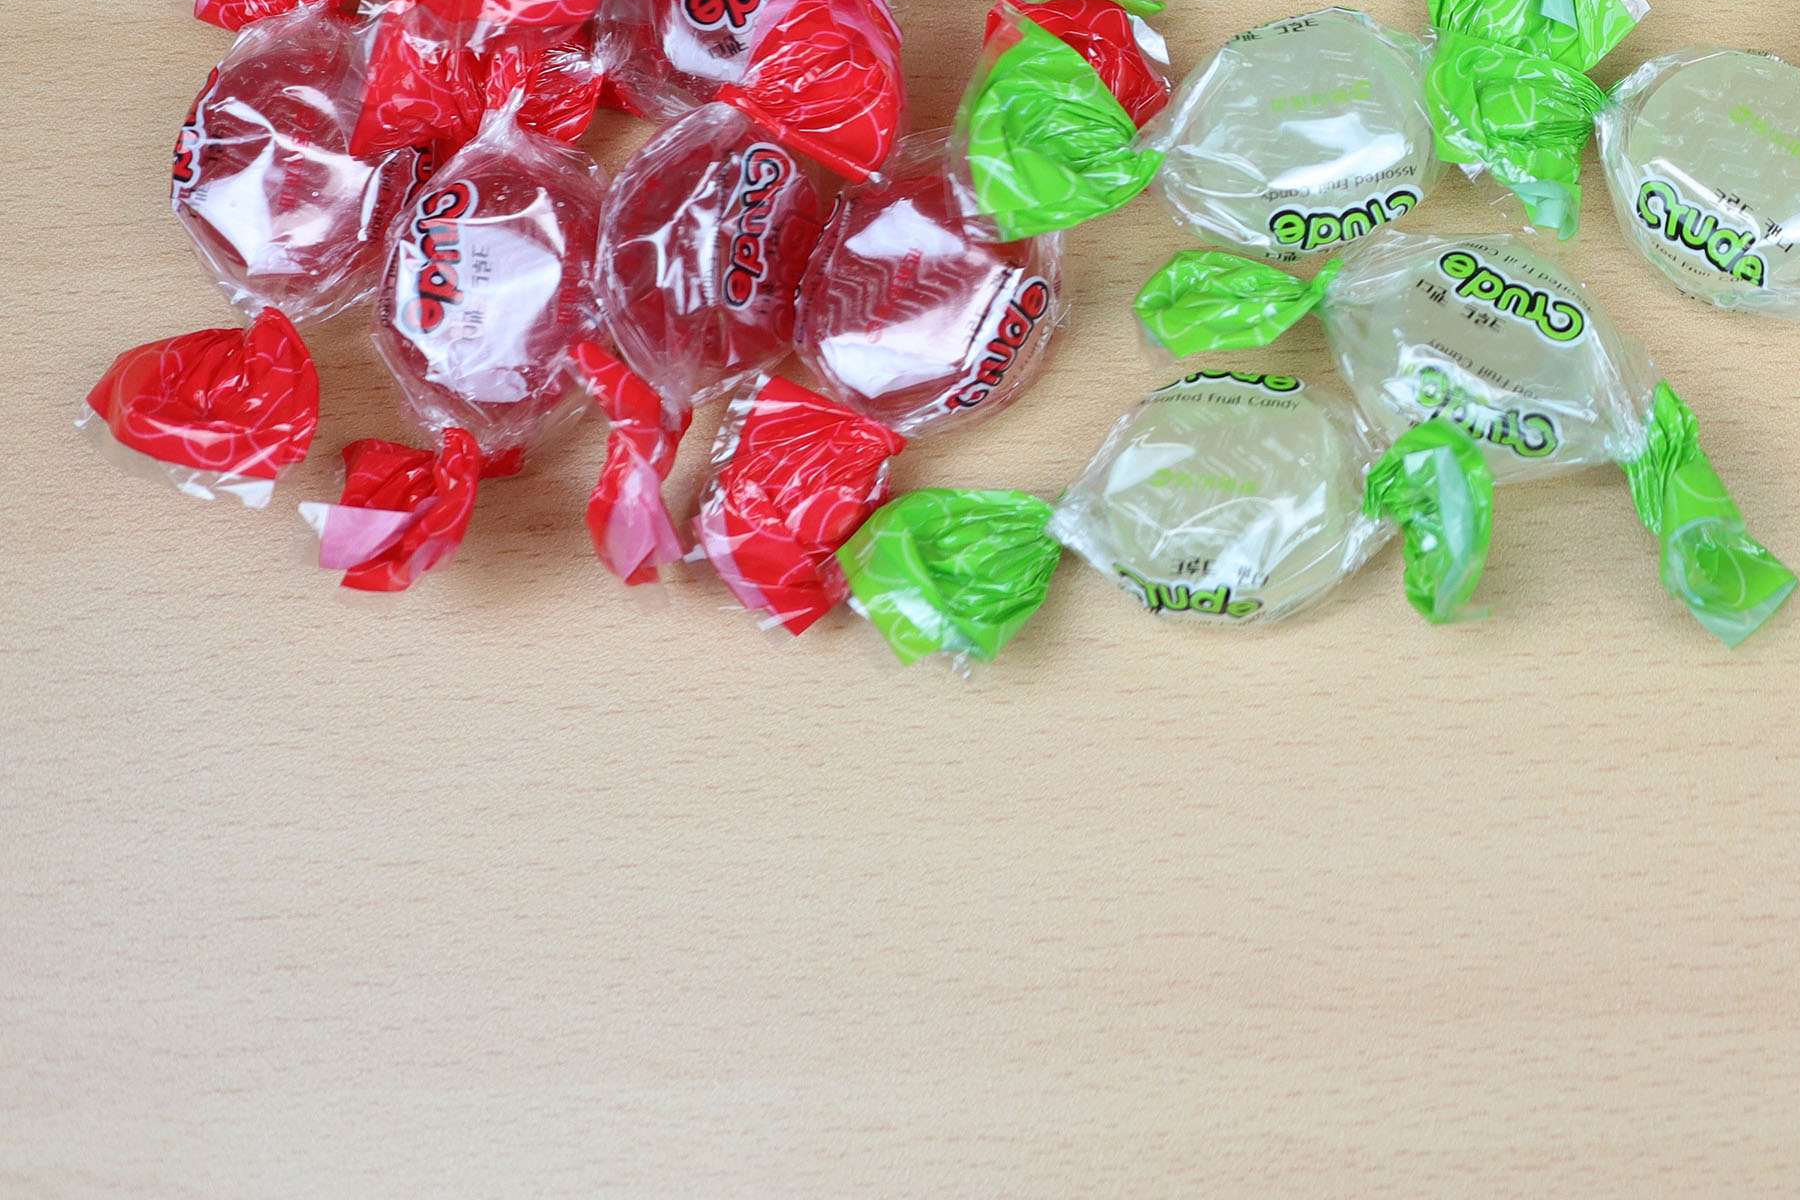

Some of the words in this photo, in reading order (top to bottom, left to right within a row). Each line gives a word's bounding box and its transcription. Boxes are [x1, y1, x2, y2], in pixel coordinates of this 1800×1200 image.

[1277, 17, 1320, 36] 크루드
[1354, 163, 1418, 187] Assorted
[1713, 186, 1756, 217] 크루드
[724, 148, 792, 308] Crude
[1637, 181, 1764, 288] Crude
[402, 181, 471, 334] Crude
[1414, 278, 1450, 309] 캔디
[1440, 250, 1584, 341] Crude
[1459, 304, 1507, 335] 크루드
[1207, 392, 1242, 406] Fruit
[1247, 395, 1302, 411] Candy
